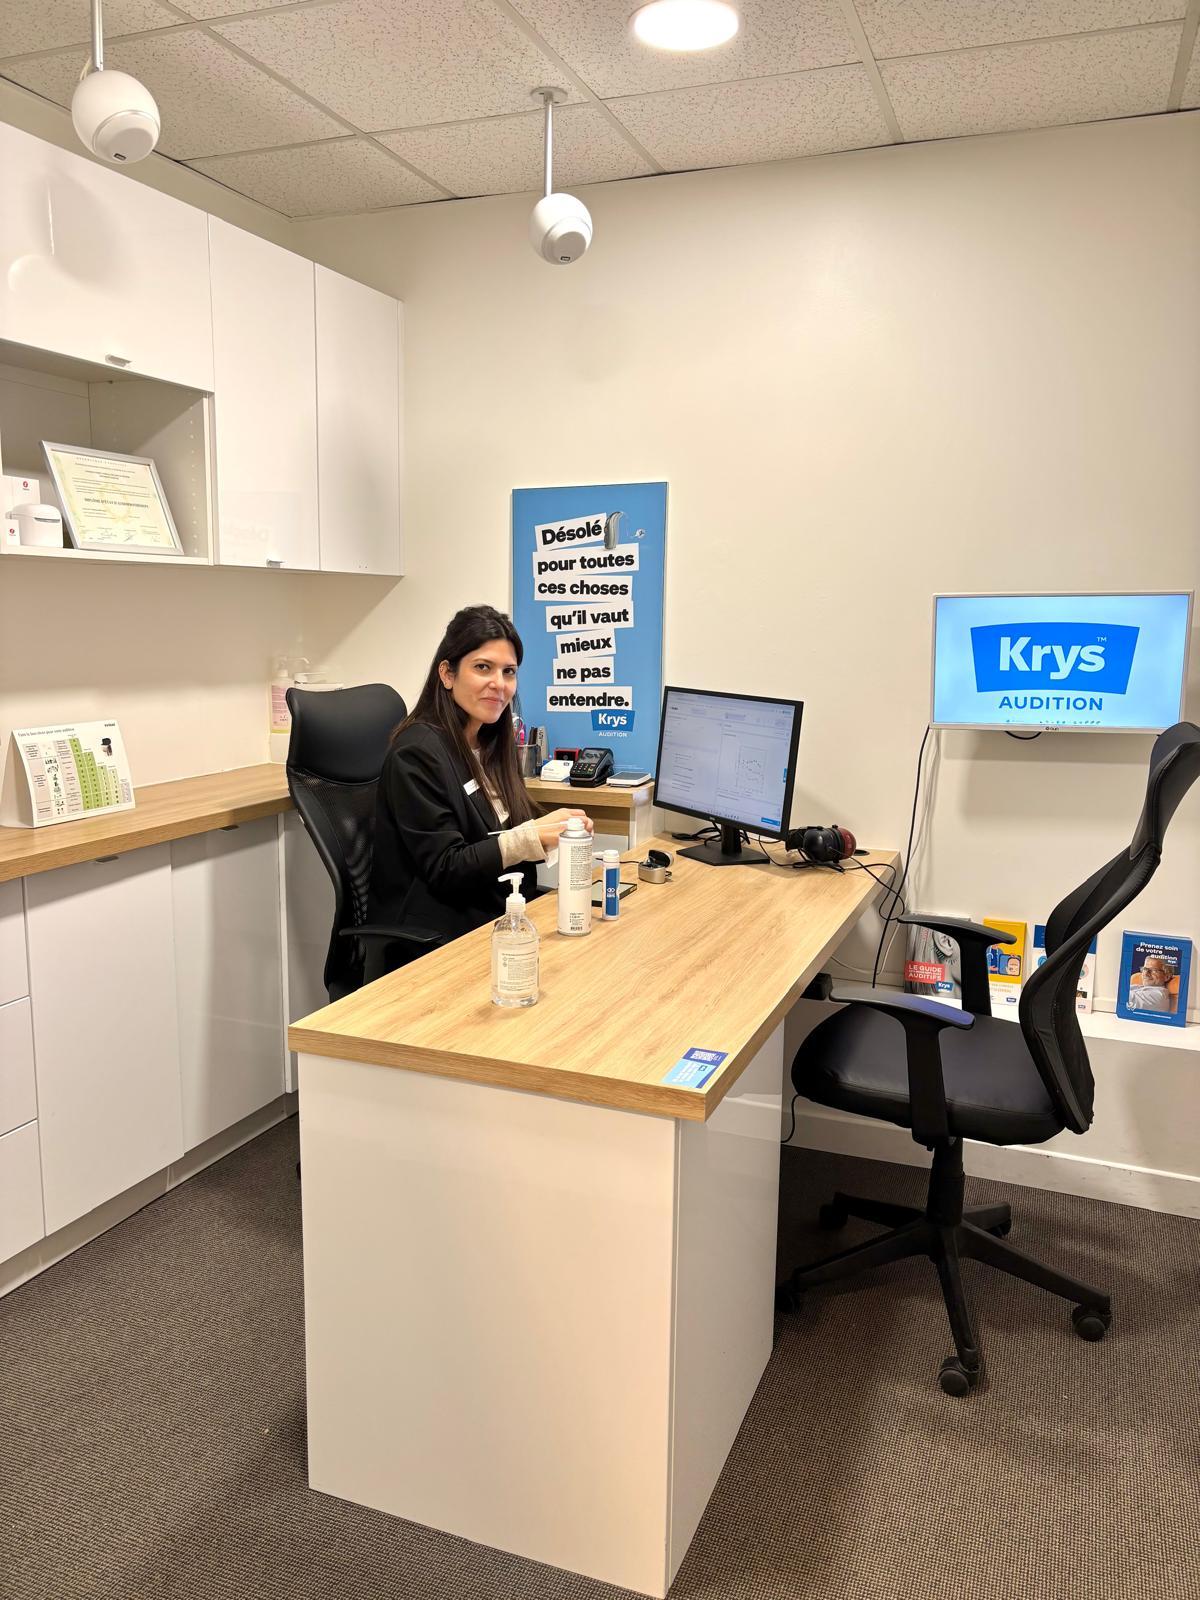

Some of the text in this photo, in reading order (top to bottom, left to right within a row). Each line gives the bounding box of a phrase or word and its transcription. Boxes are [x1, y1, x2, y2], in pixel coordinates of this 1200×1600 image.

[541, 519, 602, 546] Désolé
[537, 553, 635, 575] pour toutes
[538, 579, 629, 596] ces choses
[590, 608, 630, 624] vaut
[560, 637, 613, 654] mieux
[999, 636, 1106, 680] Krys
[556, 666, 611, 682] ne pas
[549, 691, 630, 707] entendre.
[998, 695, 1103, 711] AUDITION
[598, 712, 628, 728] Krys
[1140, 941, 1164, 950] Prenez
[1150, 953, 1178, 961] audition
[919, 965, 943, 973] GUIDE
